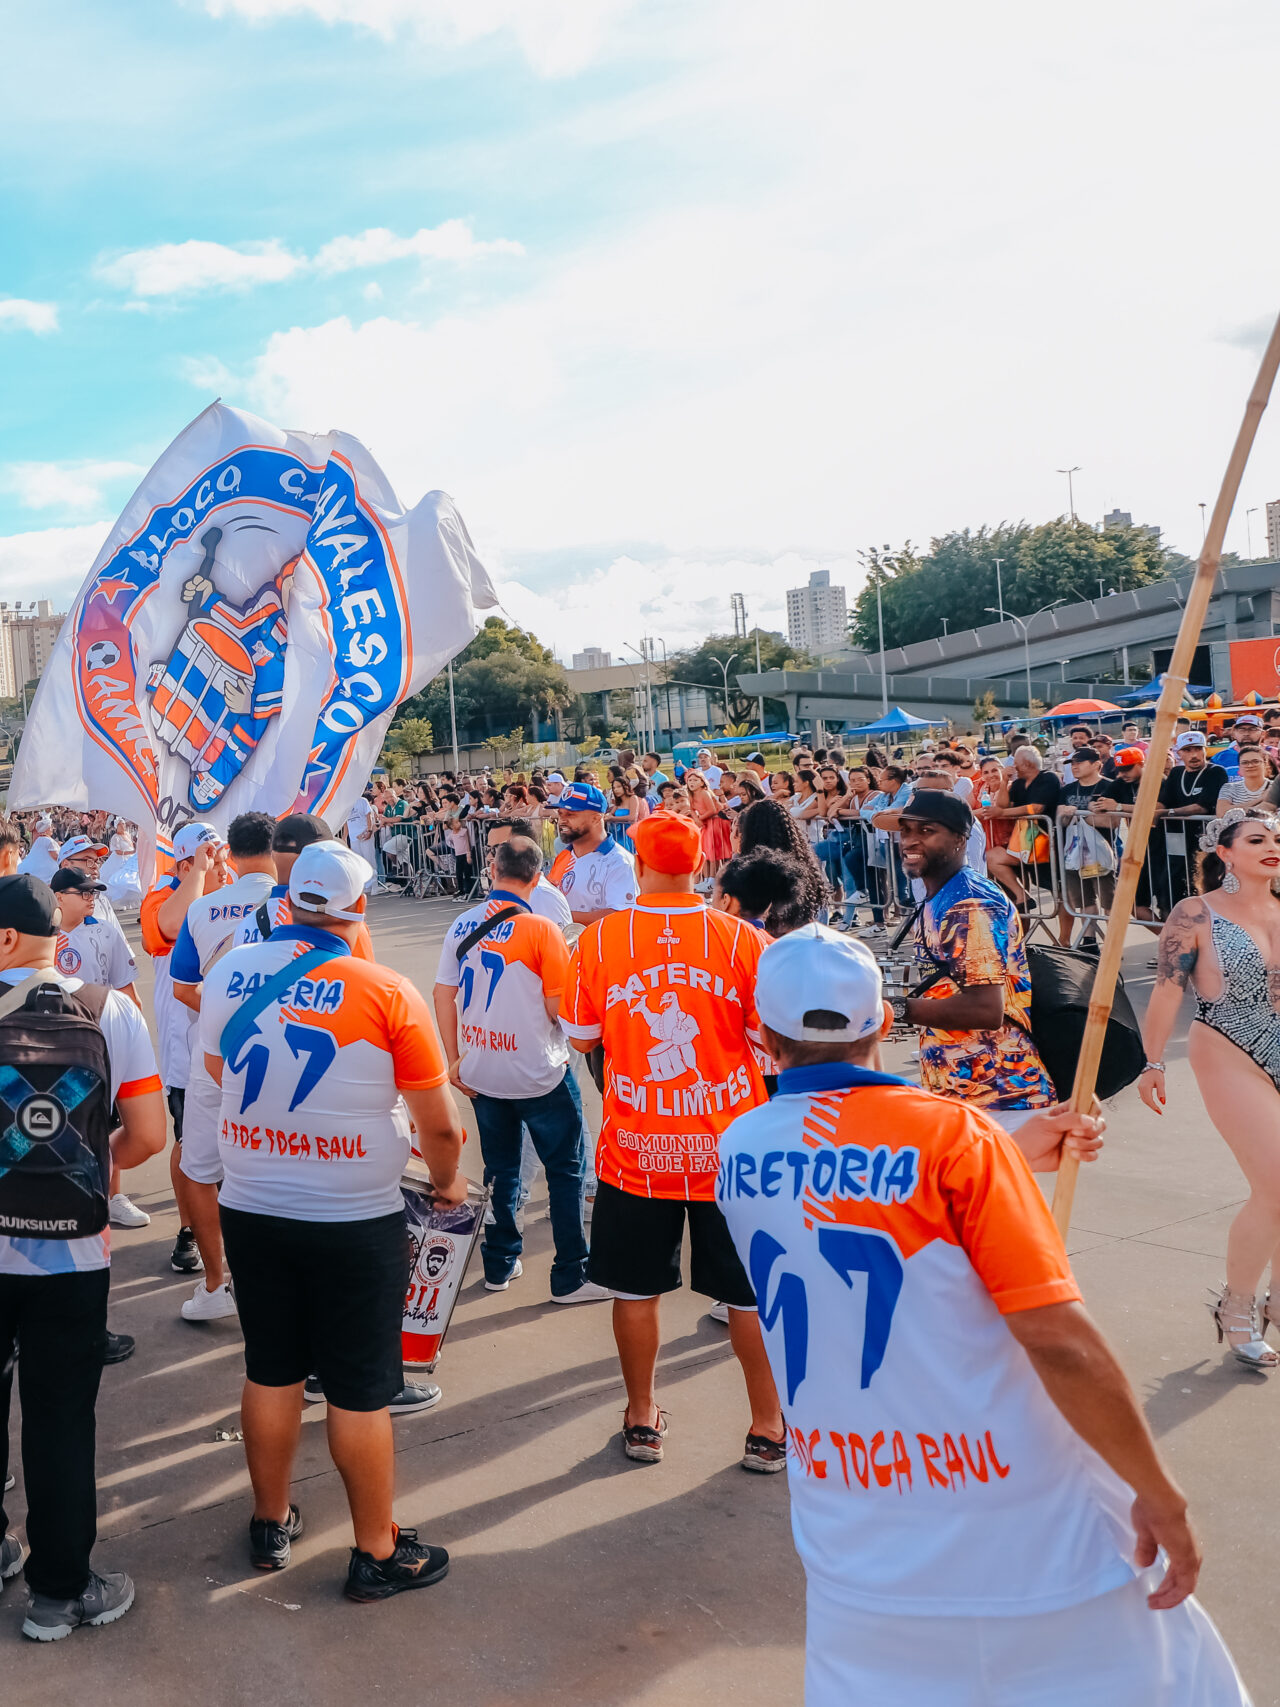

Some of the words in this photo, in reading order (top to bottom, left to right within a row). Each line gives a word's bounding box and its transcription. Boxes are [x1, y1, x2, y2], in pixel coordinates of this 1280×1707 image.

[128, 465, 242, 576] BLOCO
[210, 904, 255, 921] DIRE
[606, 962, 742, 1010] BATERIA
[490, 1031, 518, 1052] RAUL
[657, 1064, 752, 1117] LIMITES
[231, 1121, 262, 1149] TOC
[265, 1126, 310, 1160] TOCA
[314, 1134, 368, 1162] RAUL
[617, 1129, 721, 1154] COMUNID
[639, 1153, 684, 1172] QUE
[829, 1430, 912, 1496] TOCA
[916, 1429, 1010, 1493] RAUL
